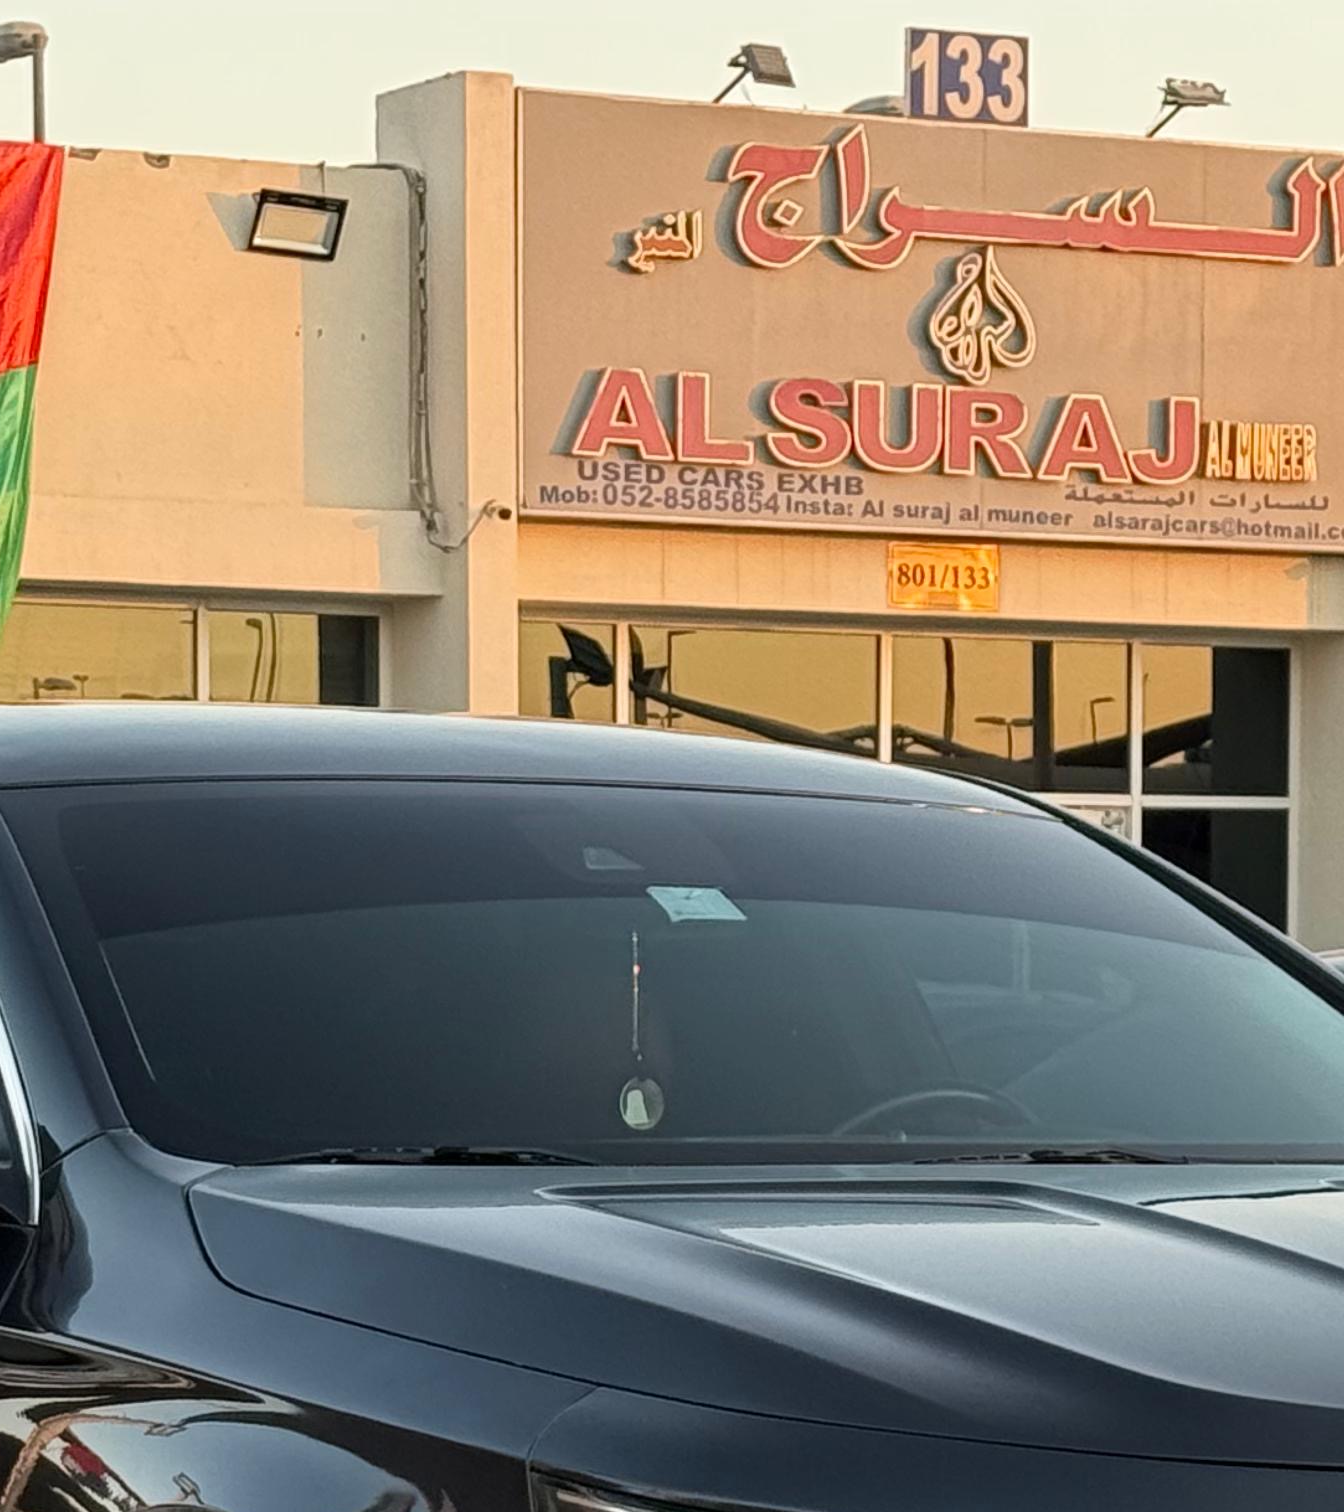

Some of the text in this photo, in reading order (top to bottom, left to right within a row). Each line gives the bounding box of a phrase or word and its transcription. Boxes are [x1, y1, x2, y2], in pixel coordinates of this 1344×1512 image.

[910, 32, 1026, 123] 133
[577, 459, 865, 497] USED CARS EXHB
[539, 485, 599, 506] Mob:
[602, 485, 781, 516] 052-8585854
[786, 495, 854, 517] Insta:
[861, 500, 885, 519] Al
[892, 502, 952, 526] suraj
[958, 504, 980, 522] al
[987, 508, 1074, 526] muneer
[897, 562, 991, 590] 801/133
